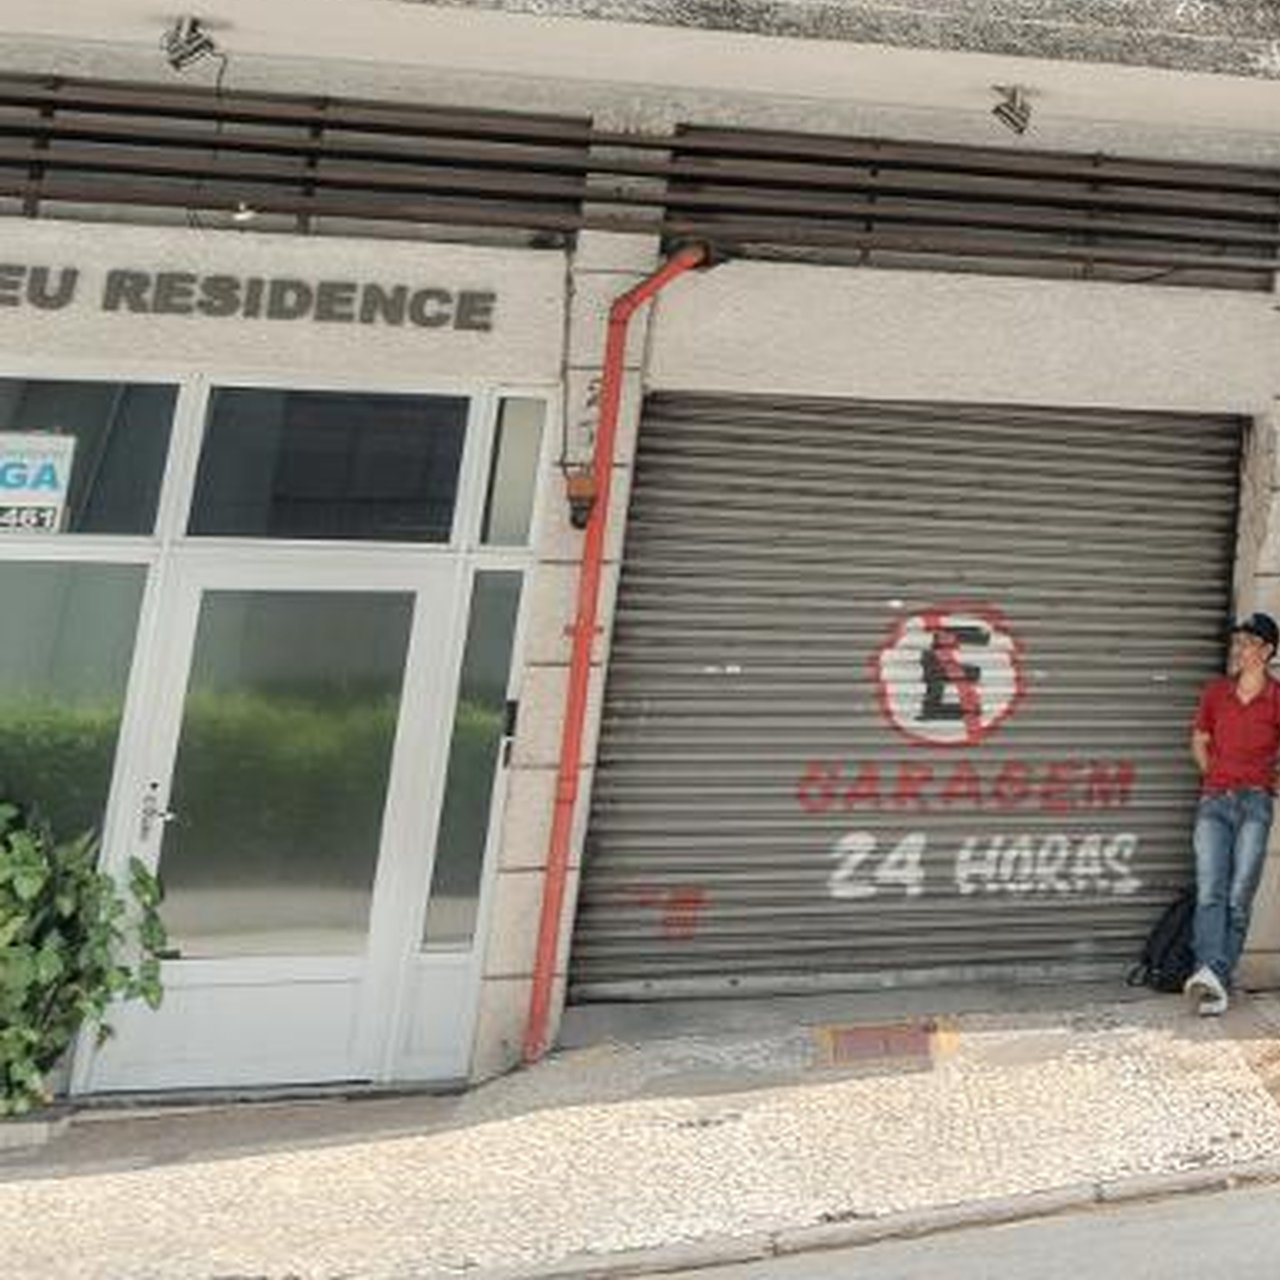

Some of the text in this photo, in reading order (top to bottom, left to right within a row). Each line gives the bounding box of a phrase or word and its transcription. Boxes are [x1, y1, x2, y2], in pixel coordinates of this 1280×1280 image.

[102, 269, 498, 332] RESIDENCE
[796, 758, 1136, 813] GARAGEM
[827, 830, 1142, 899] 24 HORAS
